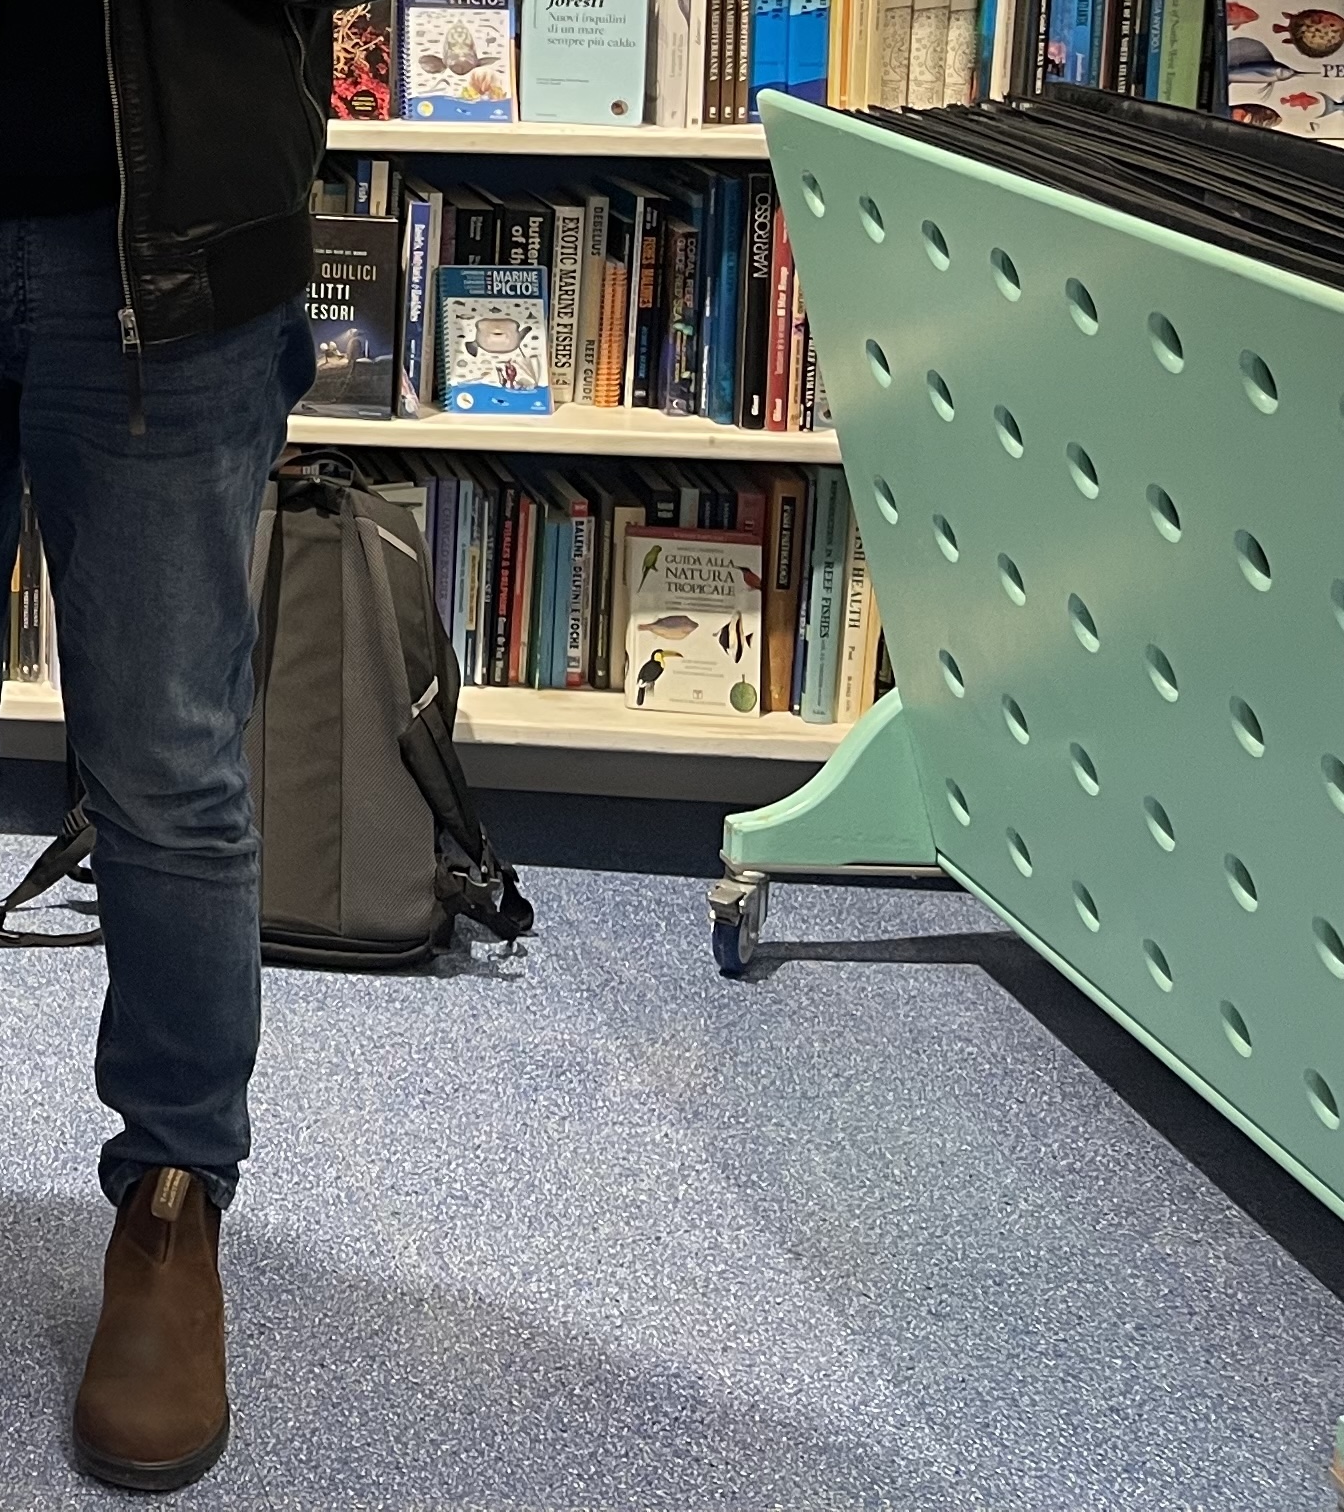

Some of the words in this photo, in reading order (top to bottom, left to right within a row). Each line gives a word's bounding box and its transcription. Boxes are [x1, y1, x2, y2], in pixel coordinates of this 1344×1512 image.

[547, 25, 558, 34] di
[547, 37, 584, 48] sempre
[587, 36, 605, 48] più
[607, 37, 636, 48] caldo
[753, 193, 771, 242] ROSSO
[560, 217, 580, 266] EXOTIC
[321, 262, 377, 281] QUILICI
[752, 243, 769, 278] MAR
[493, 271, 538, 282] MARINE
[493, 282, 532, 296] PICTO
[557, 269, 579, 318] MARINE
[554, 323, 573, 368] FISHES
[583, 339, 595, 365] REEF
[581, 368, 594, 402] GUIDE
[573, 520, 584, 561] BALENE,
[664, 553, 703, 566] GUIDA
[706, 557, 735, 568] ALLA
[664, 567, 736, 583] NATURA
[571, 565, 582, 601] DELFINI
[666, 581, 736, 596] TROPICALE
[569, 612, 581, 650] FOCHE
